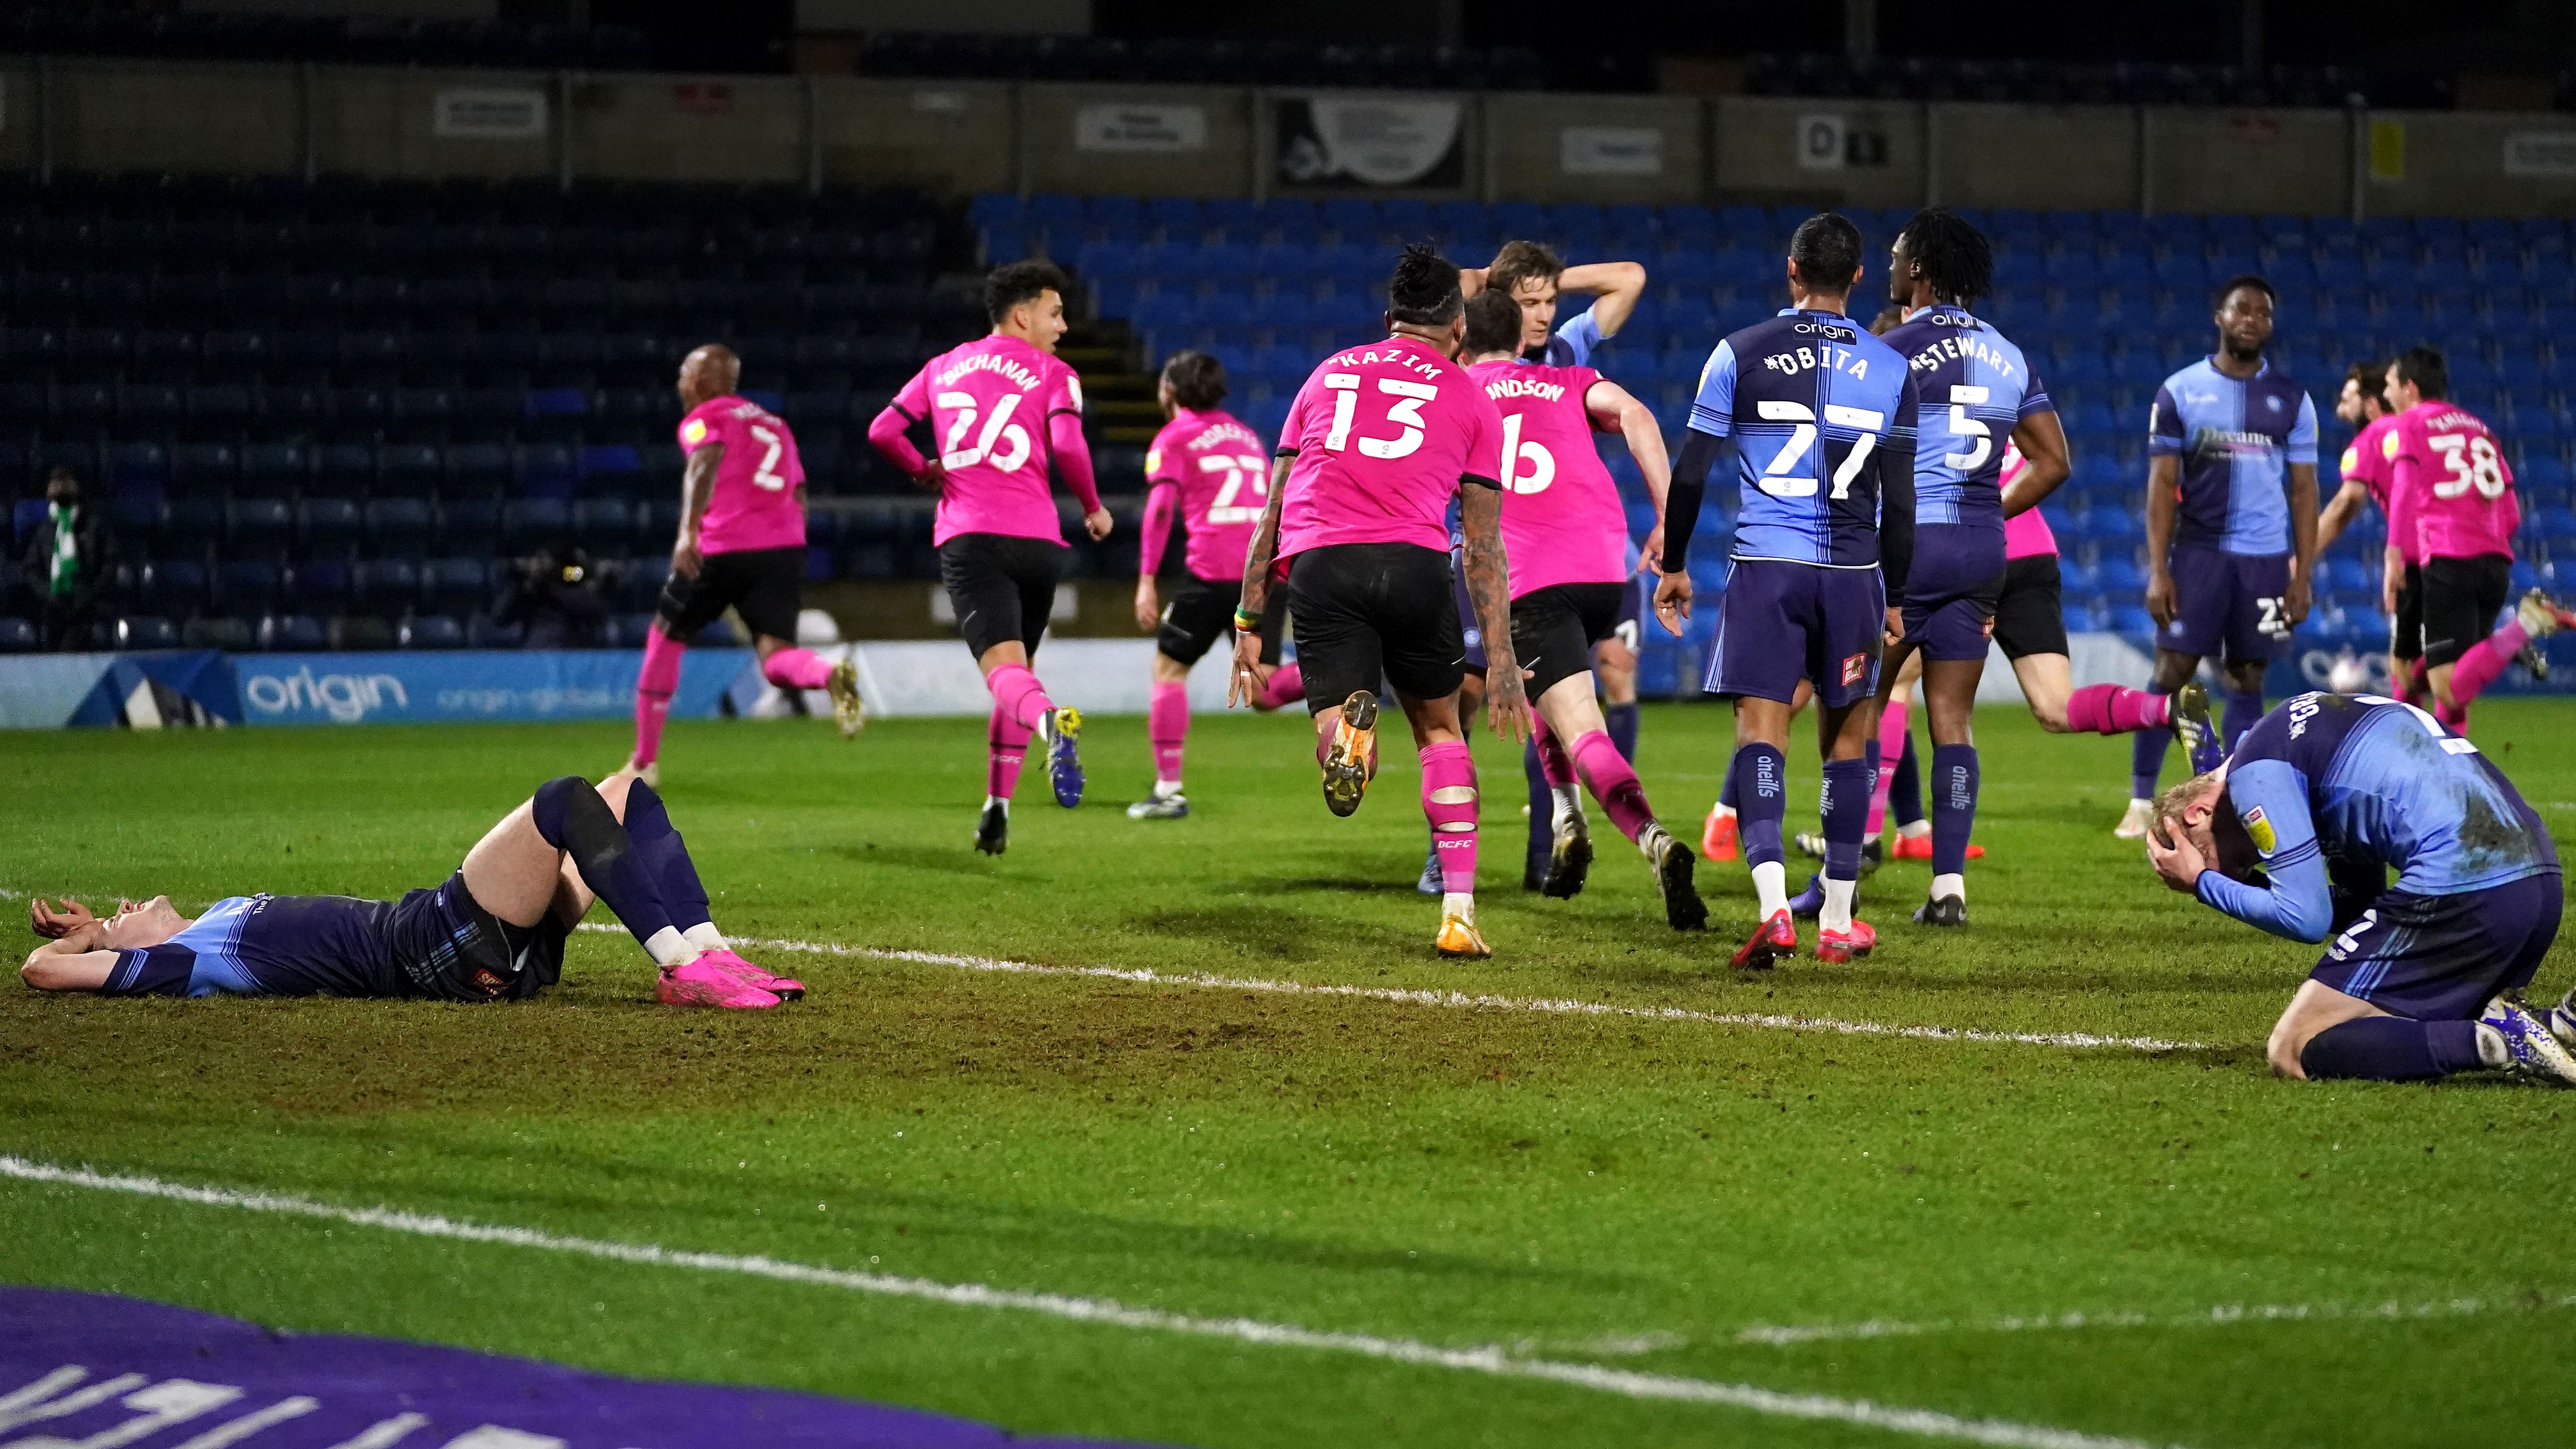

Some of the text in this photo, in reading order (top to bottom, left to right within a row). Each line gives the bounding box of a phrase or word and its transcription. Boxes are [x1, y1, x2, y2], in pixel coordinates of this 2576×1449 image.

[1794, 324, 1855, 339] origin
[943, 353, 1041, 392] BUCHANAN
[1339, 349, 1443, 381] KAZIM
[1778, 346, 1868, 381] OBITA
[1920, 336, 2014, 377] STEWART
[937, 391, 1030, 474] 26
[1324, 372, 1438, 459] 13
[1944, 384, 1992, 470] 5
[750, 425, 785, 490] 2
[1757, 401, 1884, 499] 27
[2428, 433, 2505, 499] 38
[247, 665, 408, 722] origin
[1438, 839, 1472, 848] DCFC
[253, 900, 267, 915] The
